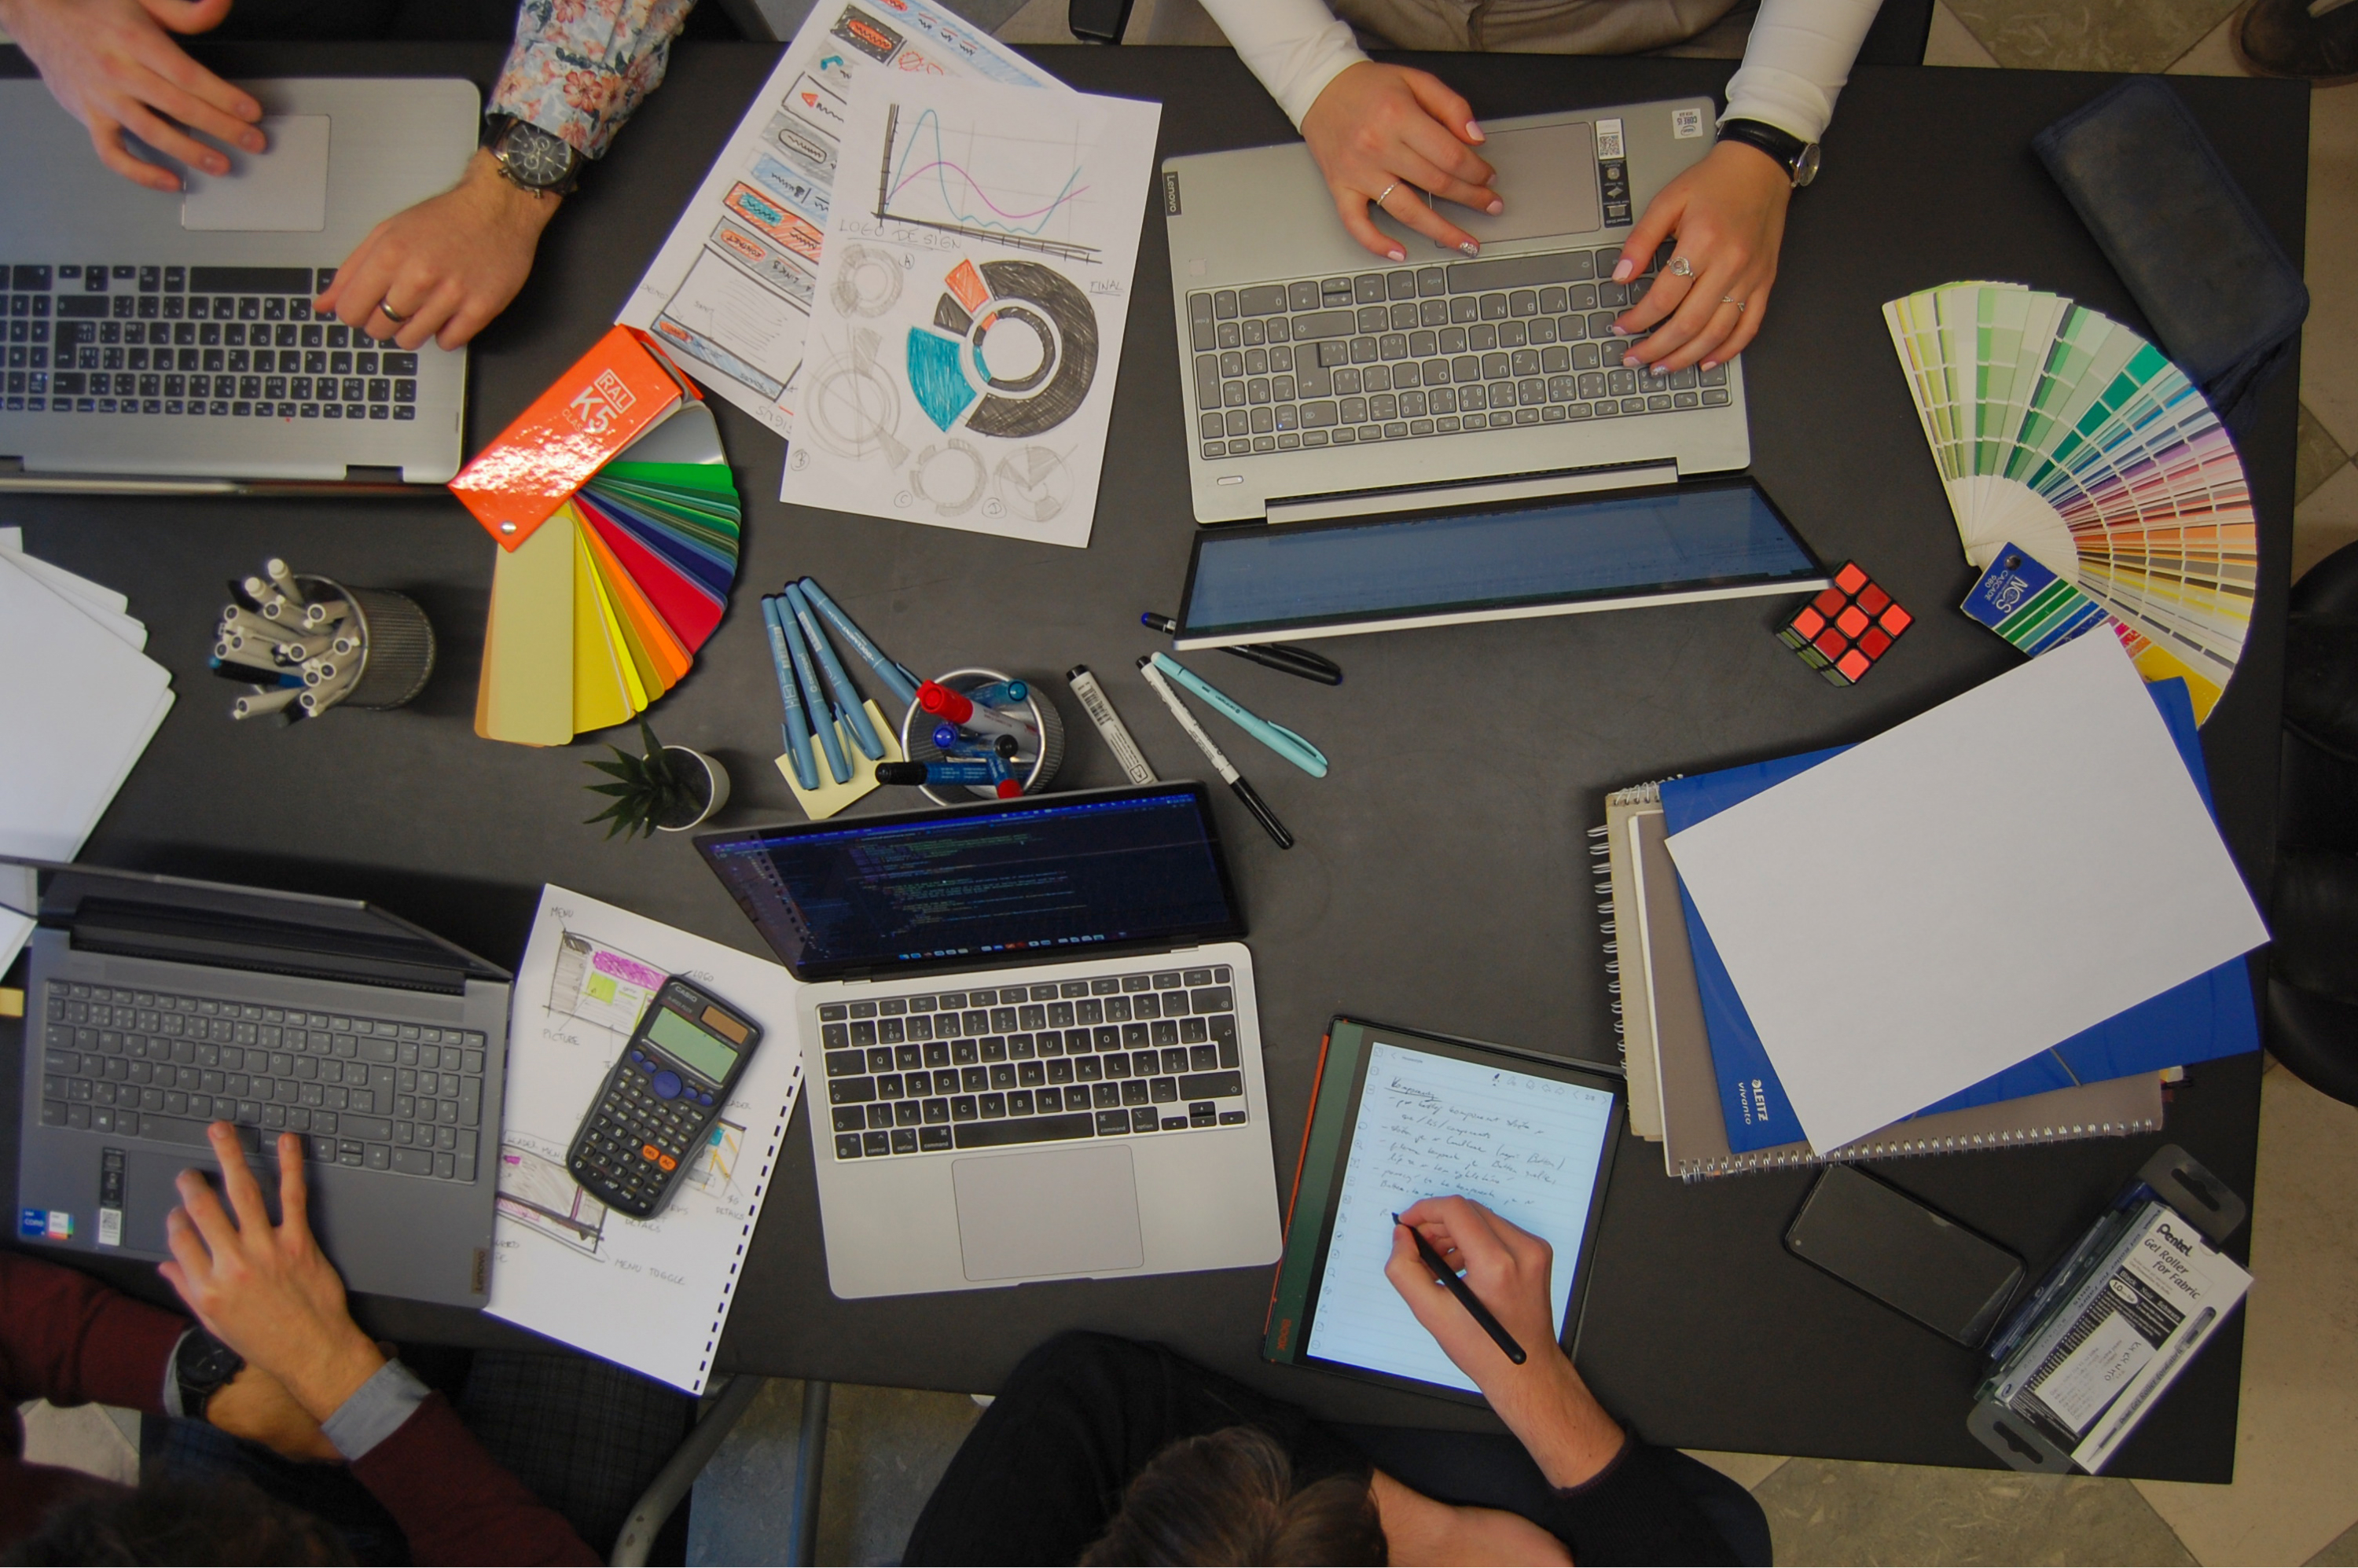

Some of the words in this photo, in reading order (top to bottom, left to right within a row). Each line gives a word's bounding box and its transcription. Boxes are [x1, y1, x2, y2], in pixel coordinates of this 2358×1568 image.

[1166, 174, 1177, 213] Lenovo
[839, 219, 885, 237] LOGO
[725, 234, 762, 259] CONTACT
[1089, 280, 1123, 292] FINAL
[599, 374, 628, 409] RAL
[570, 385, 618, 434] K5
[1985, 570, 2008, 601] CASCADE
[1996, 575, 2029, 613] NCS
[550, 906, 575, 919] MENU
[692, 969, 714, 982] LOGO
[674, 986, 698, 1003] CASIO
[542, 1028, 580, 1046] PICTURE
[1738, 1081, 1751, 1126] vivanto
[1753, 1088, 1768, 1122] LEITZ
[2143, 1238, 2162, 1253] Gel
[2159, 1250, 2190, 1276] Roller
[2156, 1223, 2193, 1258] Pentel
[474, 1250, 485, 1292] Lenovo
[614, 1259, 642, 1273] MENU
[649, 1265, 686, 1286] TOGGLE
[2152, 1259, 2172, 1275] for
[2168, 1272, 2201, 1301] Fabric
[2119, 1269, 2137, 1287] Black
[2139, 1286, 2154, 1300] Noir
[2157, 1300, 2182, 1323] Schwarz
